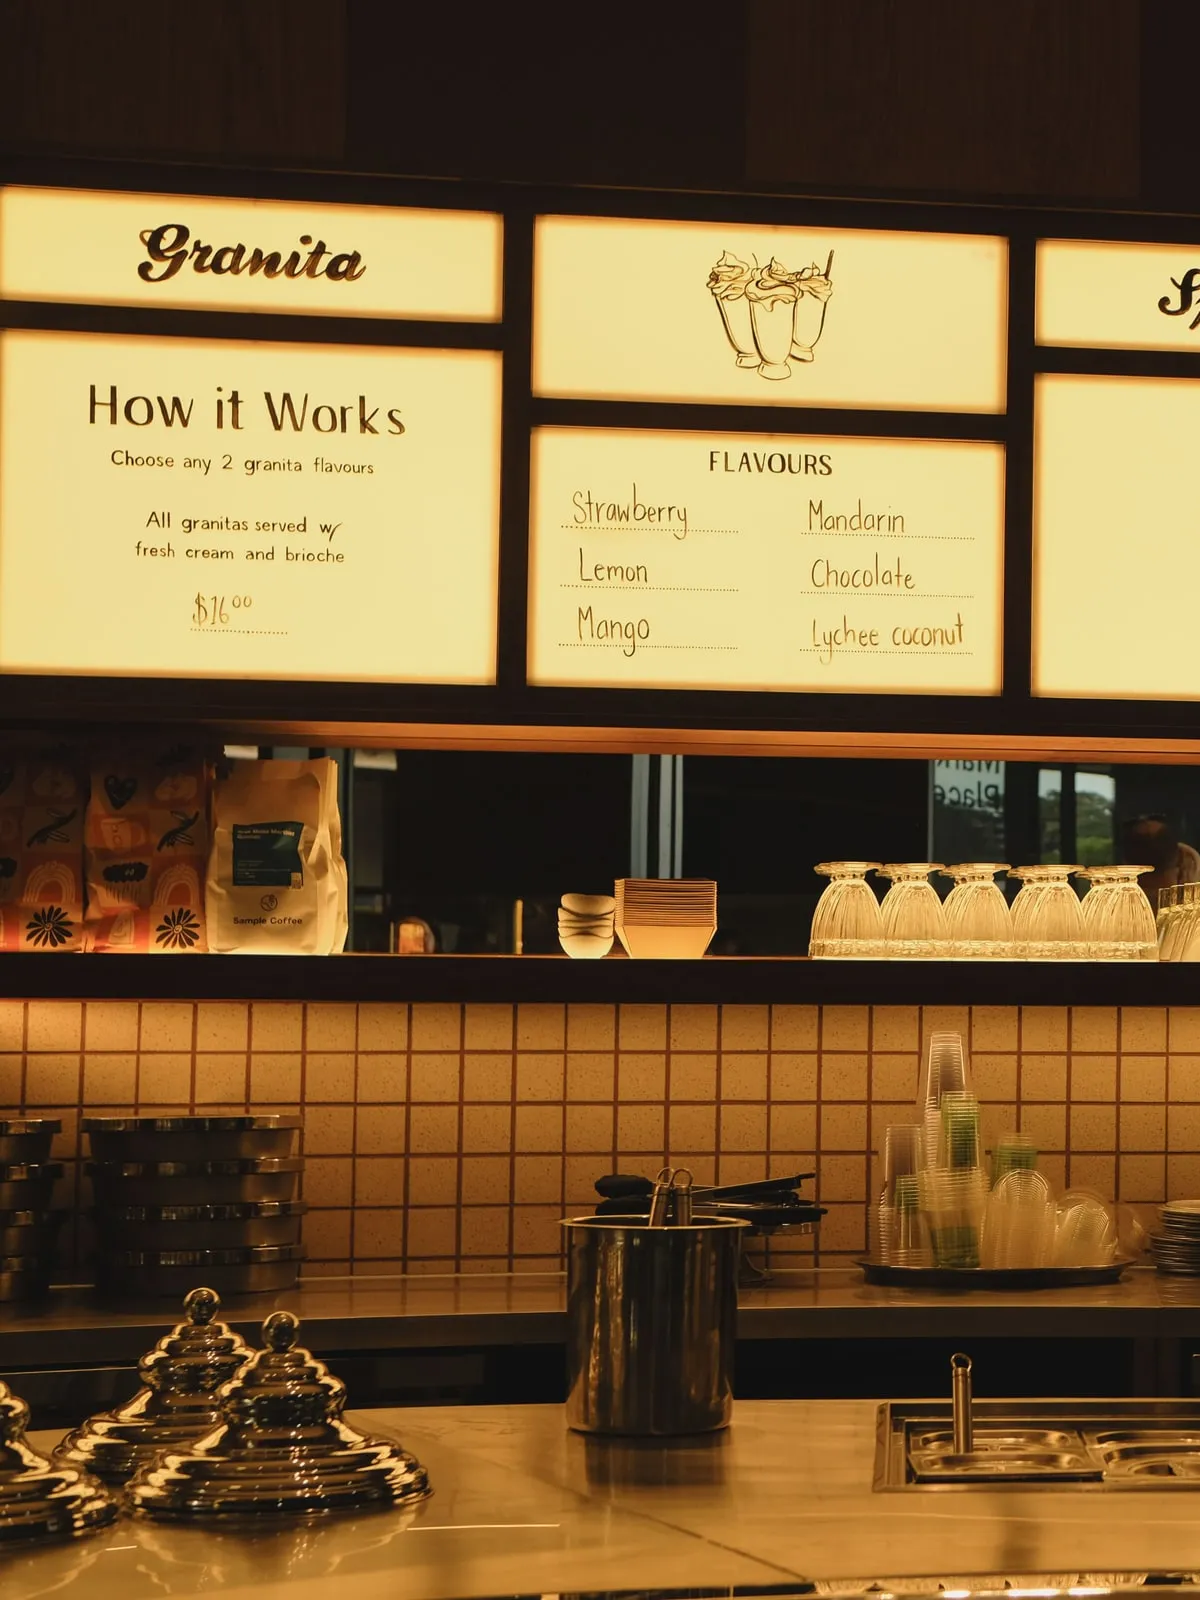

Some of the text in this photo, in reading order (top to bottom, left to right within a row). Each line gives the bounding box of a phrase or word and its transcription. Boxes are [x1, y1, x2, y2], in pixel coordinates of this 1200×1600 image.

[137, 223, 367, 283] Granita
[89, 384, 406, 435] How it Works
[111, 449, 374, 476] Choose any 2 granita flavours
[709, 450, 833, 476] FLAVOURS
[146, 511, 344, 542] All granitas served w/
[572, 482, 688, 540] Strawberry
[808, 498, 905, 534] Mandarin
[135, 541, 345, 563] fresh cream and brioche
[579, 547, 648, 583] Lemon
[811, 552, 916, 590] Chocolate
[578, 605, 650, 657] Mango
[813, 612, 965, 665] Lychee coconut
[233, 917, 303, 926] Sample Coffee
